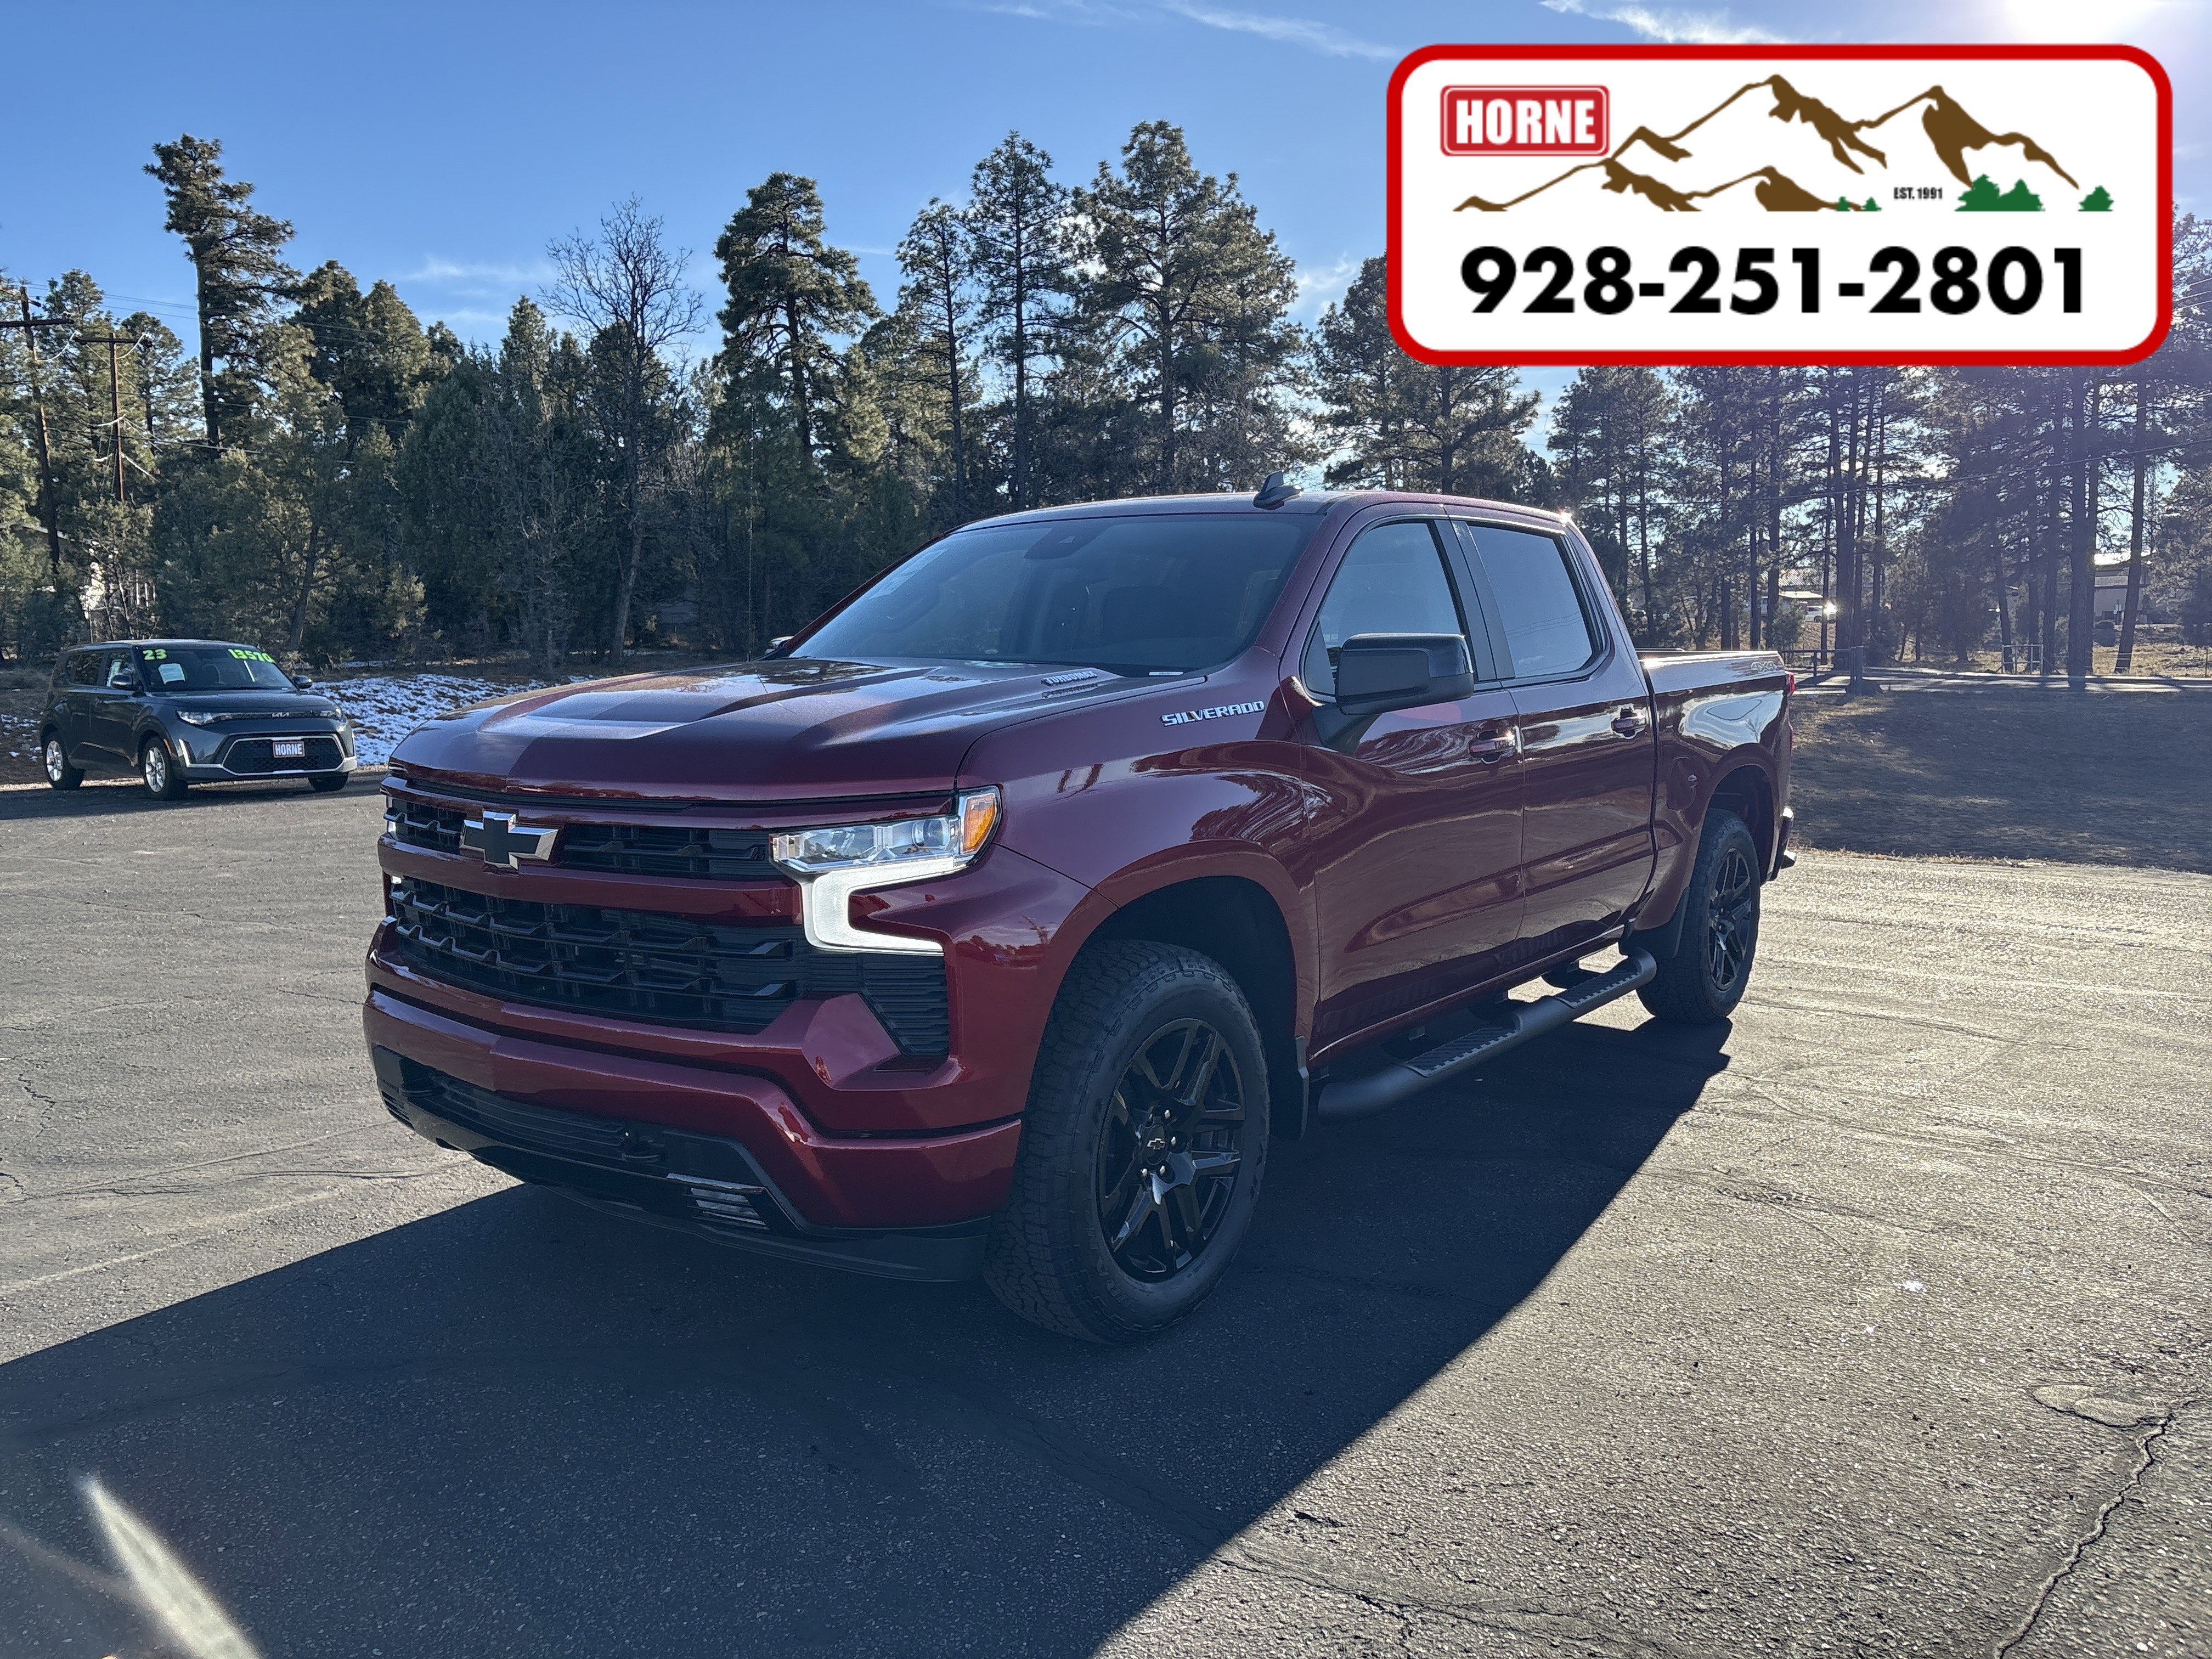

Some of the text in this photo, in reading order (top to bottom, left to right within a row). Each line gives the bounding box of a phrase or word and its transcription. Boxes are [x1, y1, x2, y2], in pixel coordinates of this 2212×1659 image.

[143, 649, 167, 661] 23
[228, 648, 275, 663] 13570
[1042, 670, 1098, 685] TURBOMAX
[1161, 701, 1265, 726] SILVERADO
[275, 743, 302, 755] HORNE
